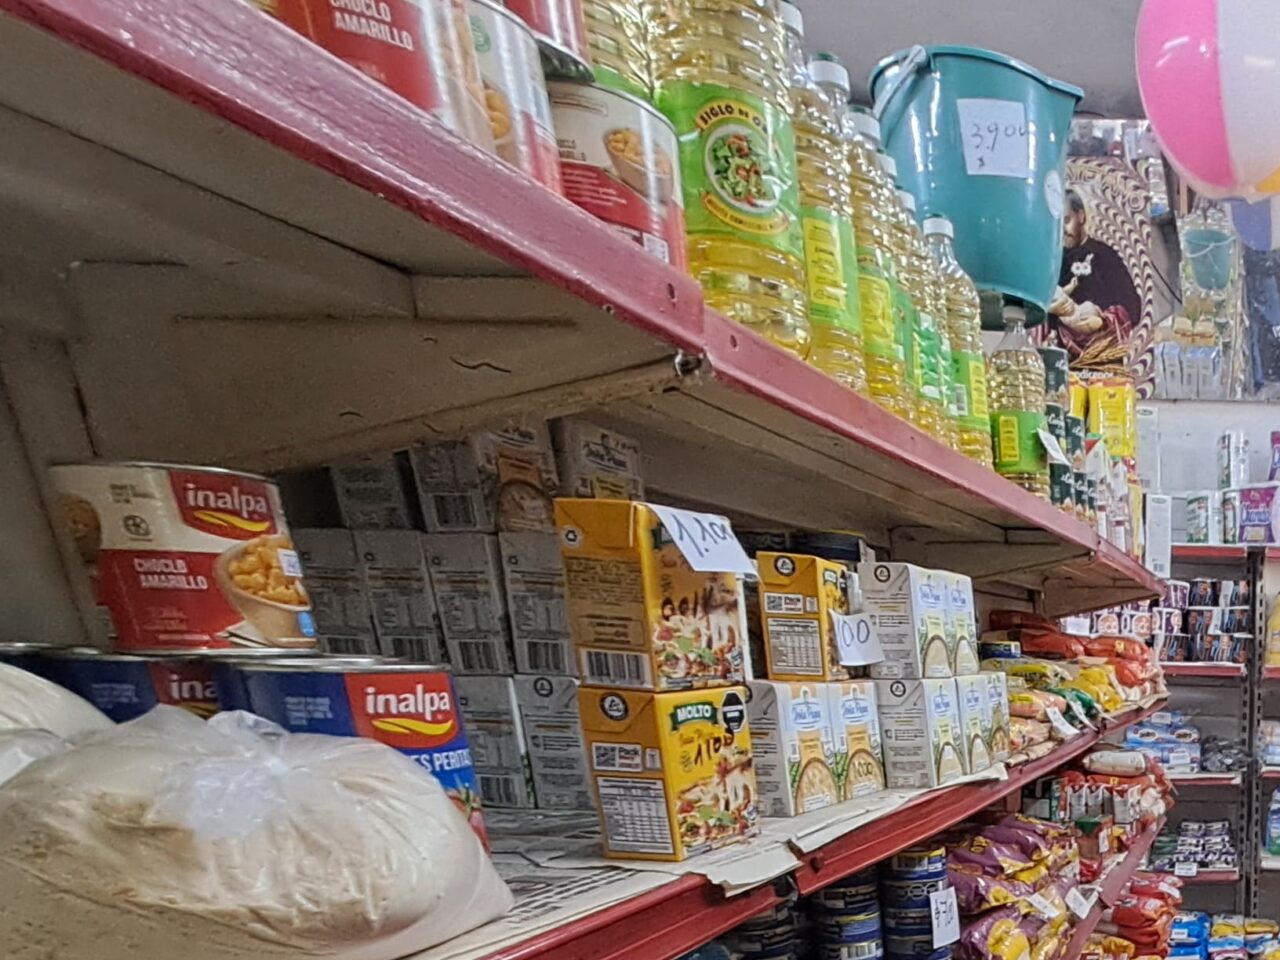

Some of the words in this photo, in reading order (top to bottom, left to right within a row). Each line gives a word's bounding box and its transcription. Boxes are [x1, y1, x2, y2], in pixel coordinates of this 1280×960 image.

[334, 12, 415, 51] AMARILLO
[700, 104, 734, 125] SIGLO
[185, 482, 269, 520] inalpa
[133, 558, 188, 573] CHOCLO
[140, 574, 209, 590] AMARILLO
[365, 683, 450, 721] inalpa
[677, 704, 712, 722] MOLTO
